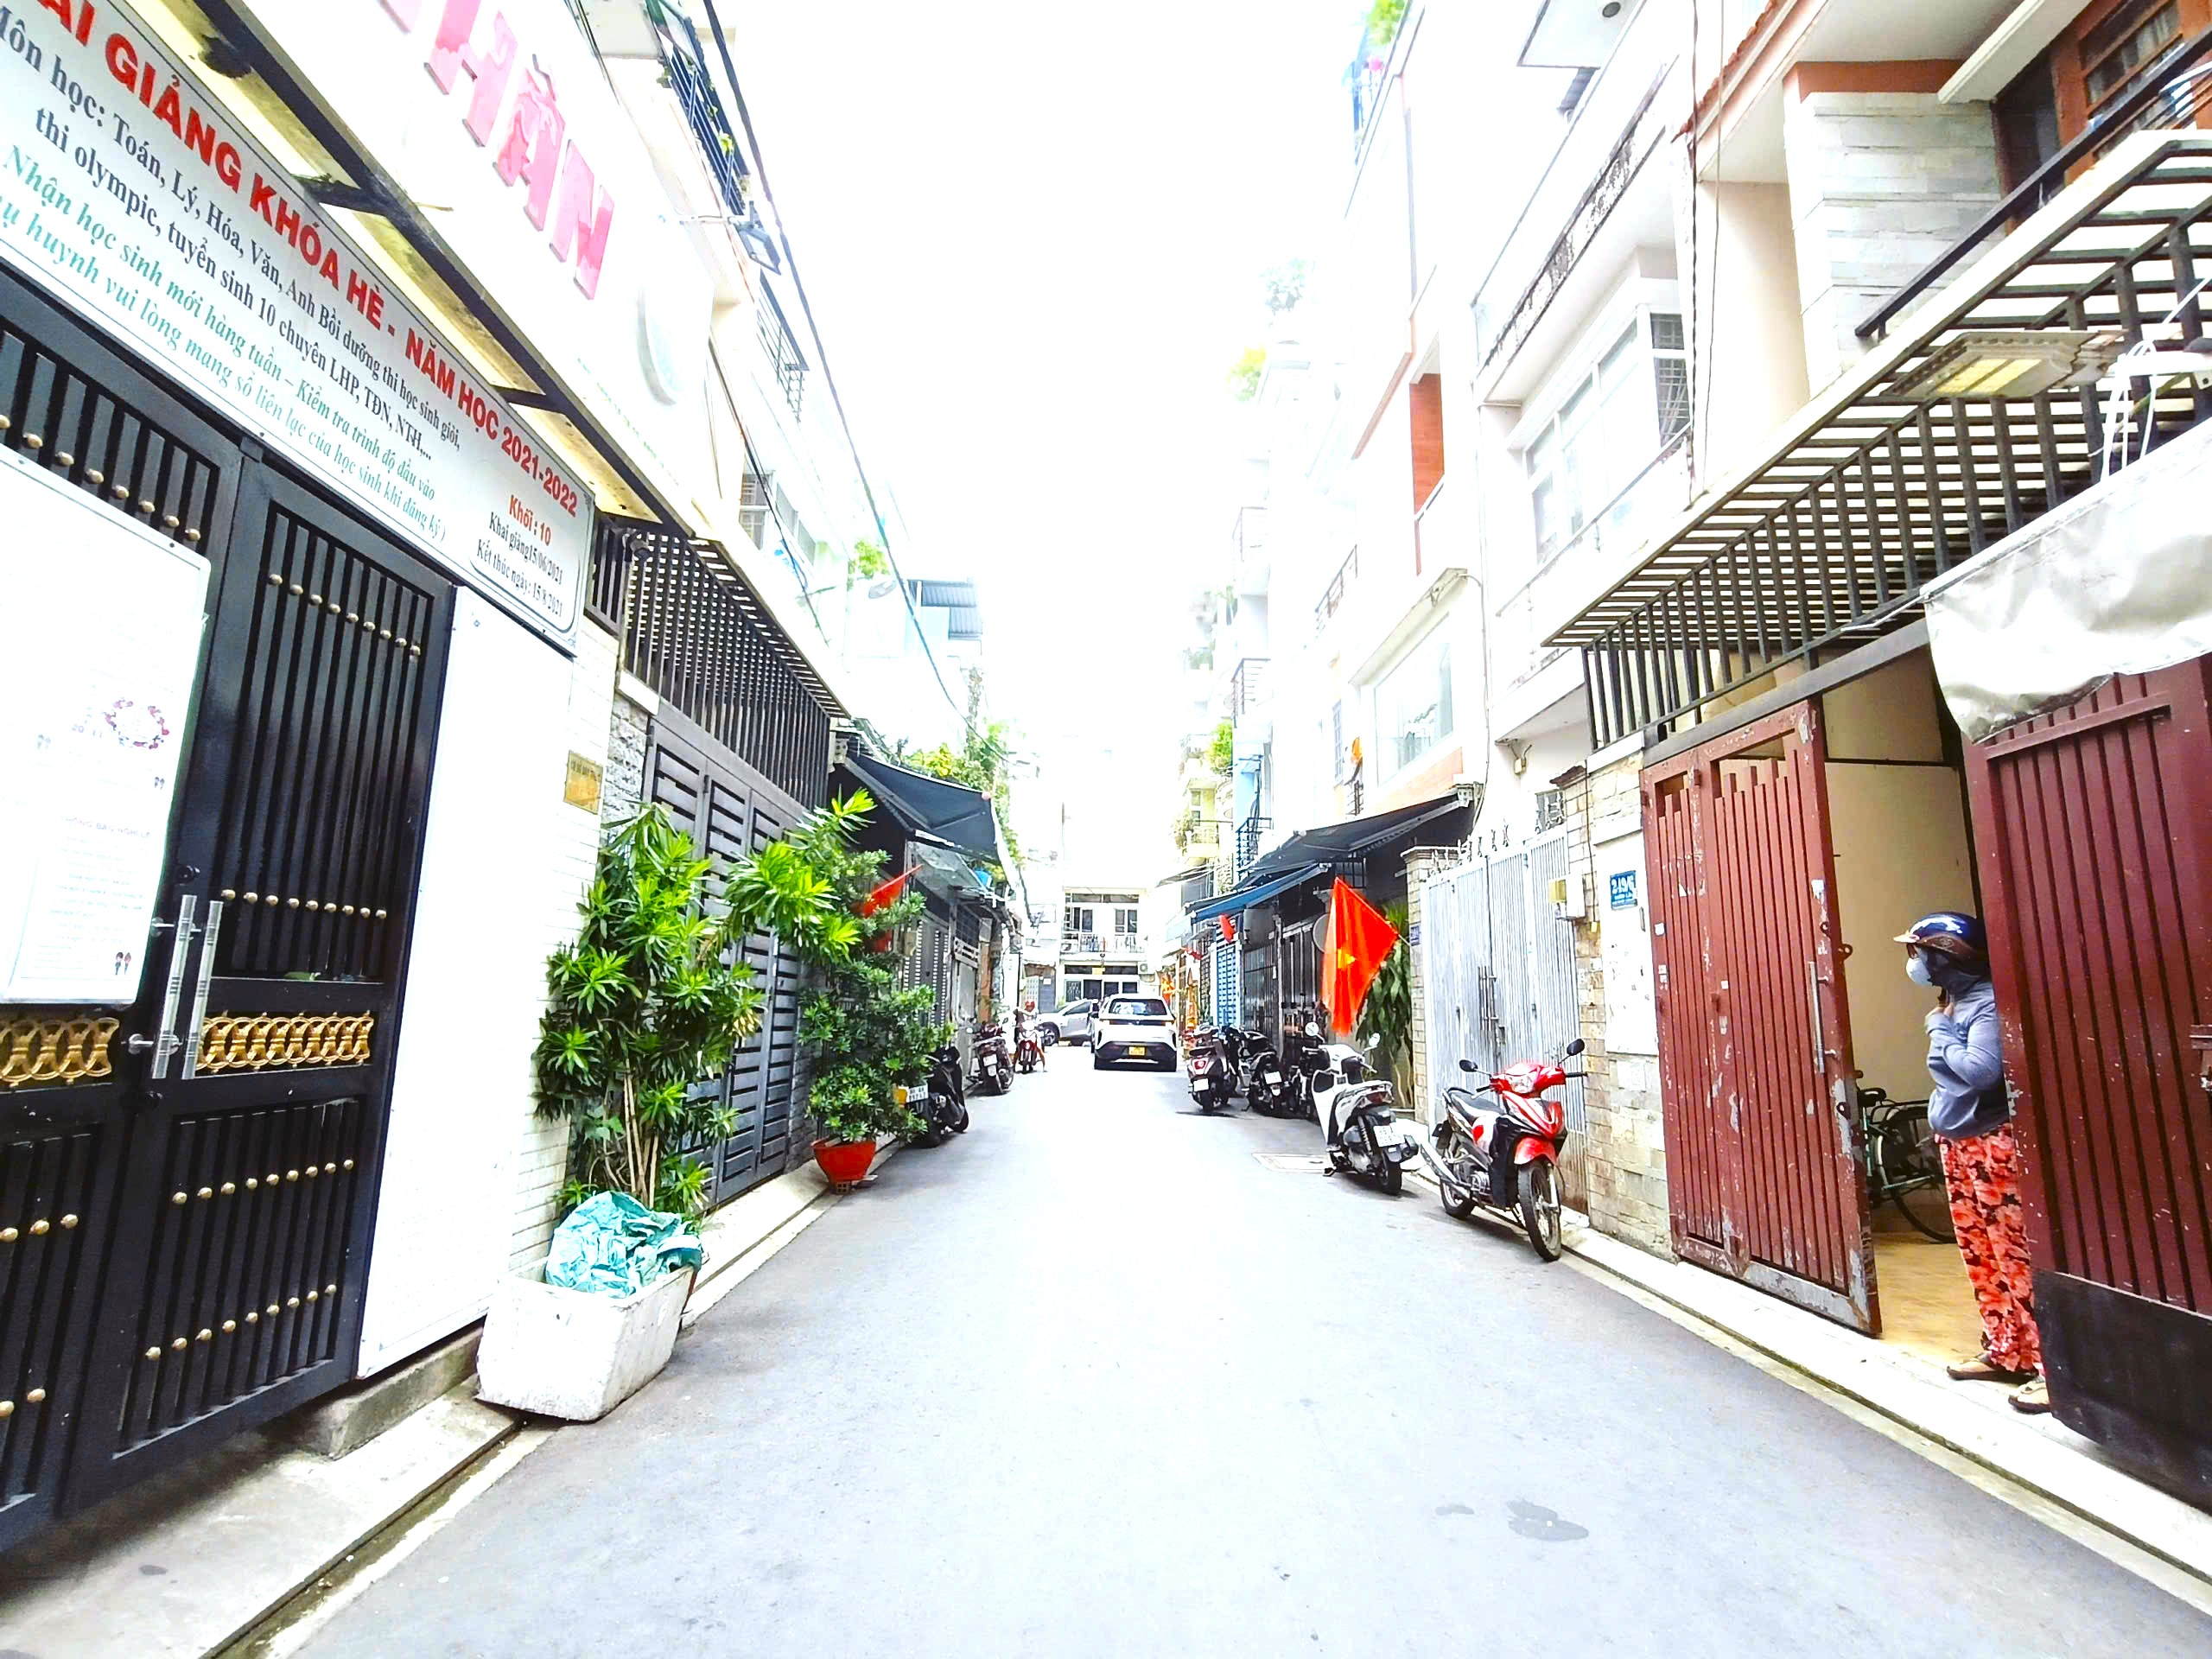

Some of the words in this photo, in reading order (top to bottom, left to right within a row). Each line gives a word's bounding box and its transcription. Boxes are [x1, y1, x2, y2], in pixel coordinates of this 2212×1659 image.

[35, 107, 70, 154] thi
[74, 146, 162, 237] olympic,
[168, 221, 217, 279] tuyển
[220, 270, 254, 311] sinh
[258, 296, 276, 327] 10
[279, 321, 327, 372] chuyên
[330, 357, 360, 404] LHP,
[364, 386, 393, 431] TĐN,
[37, 0, 95, 47] AI
[105, 33, 242, 194] GIẢNG
[249, 172, 340, 290] KHÓA
[346, 269, 385, 331] HÈ
[405, 327, 455, 399] NĂM
[457, 379, 499, 440] HỌC
[501, 426, 578, 518] 2021-2022
[50, 54, 105, 127] học:
[113, 113, 166, 188] Toán,
[171, 168, 200, 219] Lý,
[207, 200, 245, 258] Hóa,
[251, 239, 283, 293] Văn,
[285, 278, 316, 319] Anh
[318, 303, 341, 341] Bồi
[383, 366, 398, 391] thi
[399, 379, 418, 410] học
[420, 401, 440, 429] sinh
[378, 0, 614, 300] HÂN
[3, 144, 73, 215] Nhận
[76, 203, 117, 250] học
[119, 244, 163, 287] sinh
[166, 281, 204, 318] mới
[204, 305, 246, 358] hàng
[248, 344, 283, 381] tuần
[296, 378, 331, 420] Kiểm
[332, 410, 350, 435] tra
[352, 425, 380, 459] trình
[381, 448, 397, 474] độ
[418, 478, 435, 501] vào
[26, 213, 100, 285] huynh
[105, 277, 139, 312] vui
[140, 298, 182, 351] lòng
[185, 339, 233, 389] mang
[255, 385, 283, 421] liên
[286, 407, 307, 437] lạc
[334, 443, 356, 474] học
[359, 465, 382, 493] sinh
[384, 480, 403, 508] khi
[477, 539, 492, 565] Kết
[493, 553, 511, 578] thúc
[489, 512, 510, 542] Khai
[540, 522, 551, 546] 10
